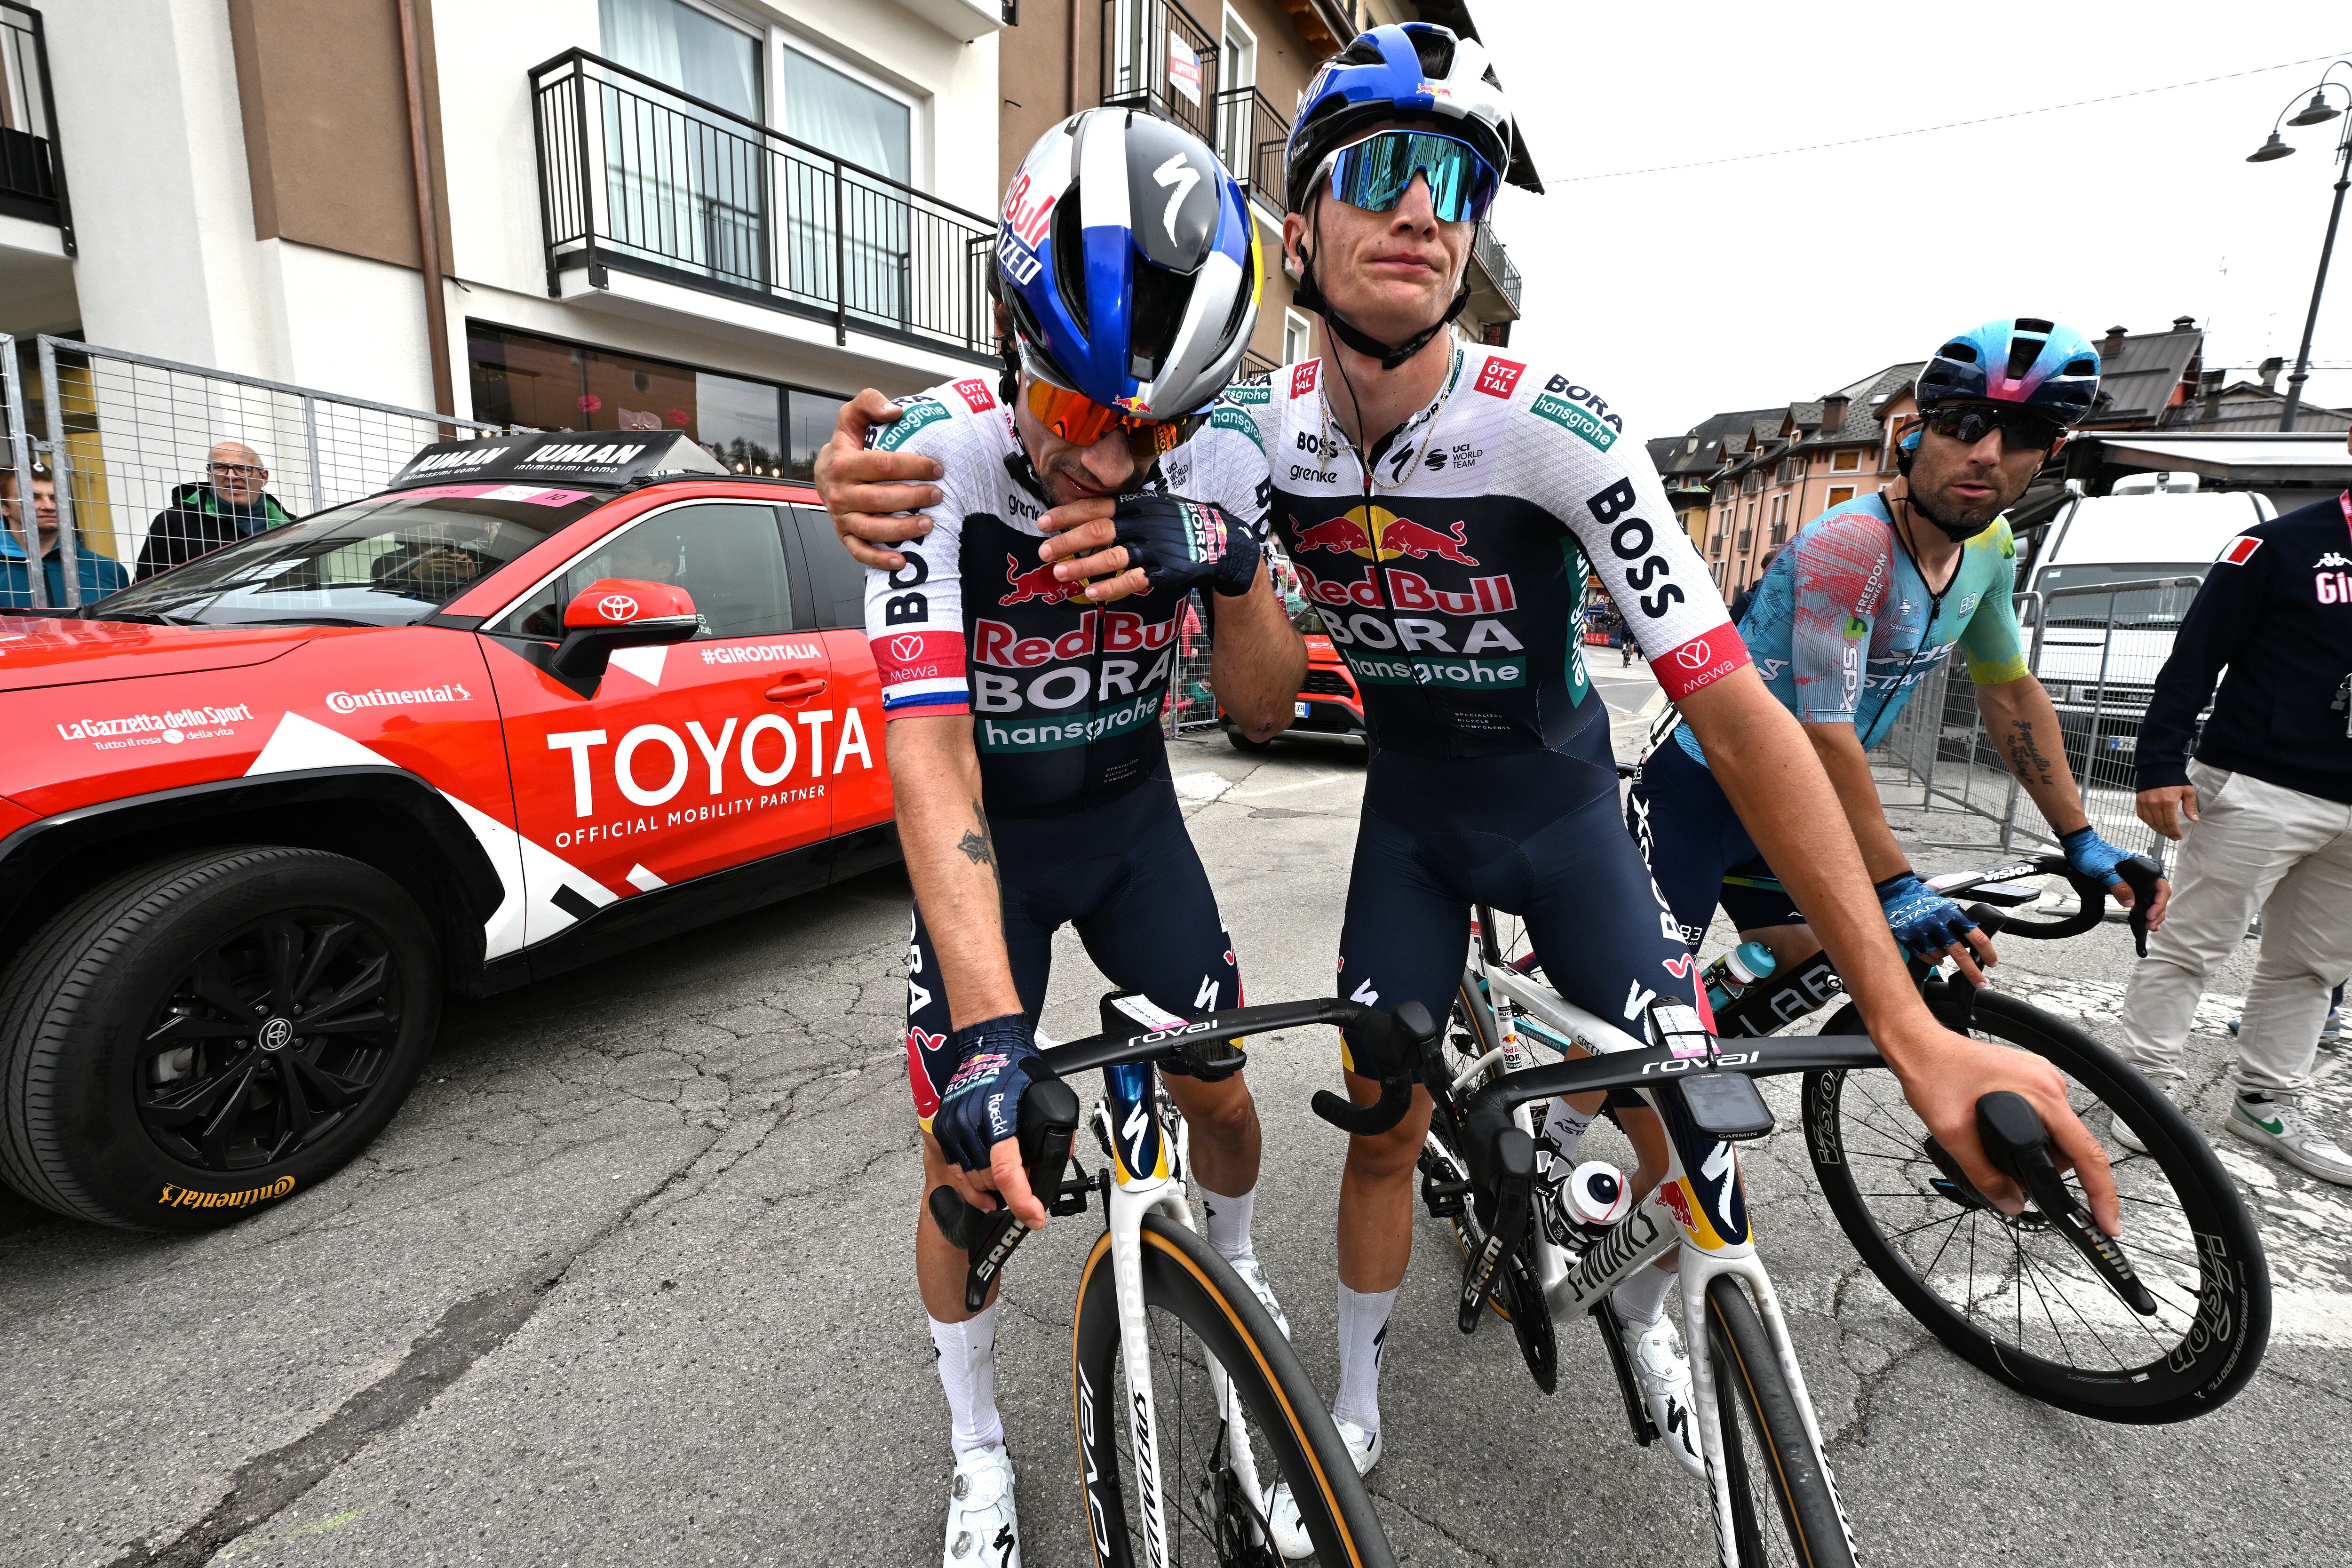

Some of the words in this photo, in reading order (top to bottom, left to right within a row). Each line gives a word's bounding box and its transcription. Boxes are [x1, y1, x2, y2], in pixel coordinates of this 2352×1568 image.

[1175, 60, 1199, 81] AFFITTA
[1484, 375, 1509, 393] TAL
[1489, 360, 1518, 380] ÖTZ
[968, 392, 991, 406] TAL
[1545, 374, 1622, 434] BORA
[875, 403, 946, 451] hansgrohe
[1536, 394, 1613, 447] hansgrohe
[523, 444, 647, 465] IUMAN
[1297, 430, 1339, 459] BOSS
[1453, 444, 1470, 453] UCI
[1453, 449, 1483, 461] WORLD
[400, 470, 452, 482] intimissimi
[453, 466, 481, 475] uomo
[410, 446, 510, 474] IUMAN
[1166, 462, 1178, 474] UCI
[1169, 464, 1188, 482] WORLD
[1290, 464, 1338, 484] grenke
[1453, 460, 1476, 469] TEAM
[1120, 490, 1159, 503] Roeckl
[1172, 477, 1187, 490] TEAM
[1008, 494, 1044, 521] grenk
[1185, 502, 1208, 564] BORA
[1586, 477, 1685, 619] BOSS
[1294, 564, 1385, 610] Red
[1385, 567, 1517, 616] Bull
[1855, 552, 1888, 613] FREEDOM
[2315, 572, 2352, 604] Gi
[1865, 582, 1884, 615] BROKER
[1959, 592, 1976, 613] B3
[973, 609, 1097, 668] Red
[1103, 594, 1191, 653] Bull
[1319, 607, 1525, 654] BORA
[700, 644, 822, 665] #GIRODITALIA
[975, 649, 1171, 713] BORA
[1349, 657, 1520, 685] hansgrohe
[207, 702, 254, 724] Sport
[325, 684, 454, 715] Continental
[985, 696, 1158, 747] hansgrohe
[92, 739, 126, 752] Tutto
[135, 737, 162, 747] rosa
[186, 729, 213, 740] della
[214, 727, 234, 738] vita
[546, 707, 874, 819] TOYOTA
[555, 817, 659, 849] OFFICIAL
[667, 797, 755, 828] MOBILITY
[760, 784, 826, 809] PARTNER
[1889, 899, 1951, 930] ASTANA
[1128, 1019, 1218, 1047] roval
[1521, 1027, 1561, 1051] SHIMANO
[1577, 1035, 1605, 1056] SPECI
[1642, 1051, 1760, 1075] roval
[945, 1067, 1000, 1095] BORA
[988, 1093, 1008, 1137] Roeckl
[171, 1175, 297, 1210] Continental
[1567, 1205, 1660, 1303] S-WORKS
[2066, 1209, 2134, 1280] SRAM
[1464, 1235, 1503, 1307] SRAM
[1132, 1390, 1170, 1568] SPECIALIZE
